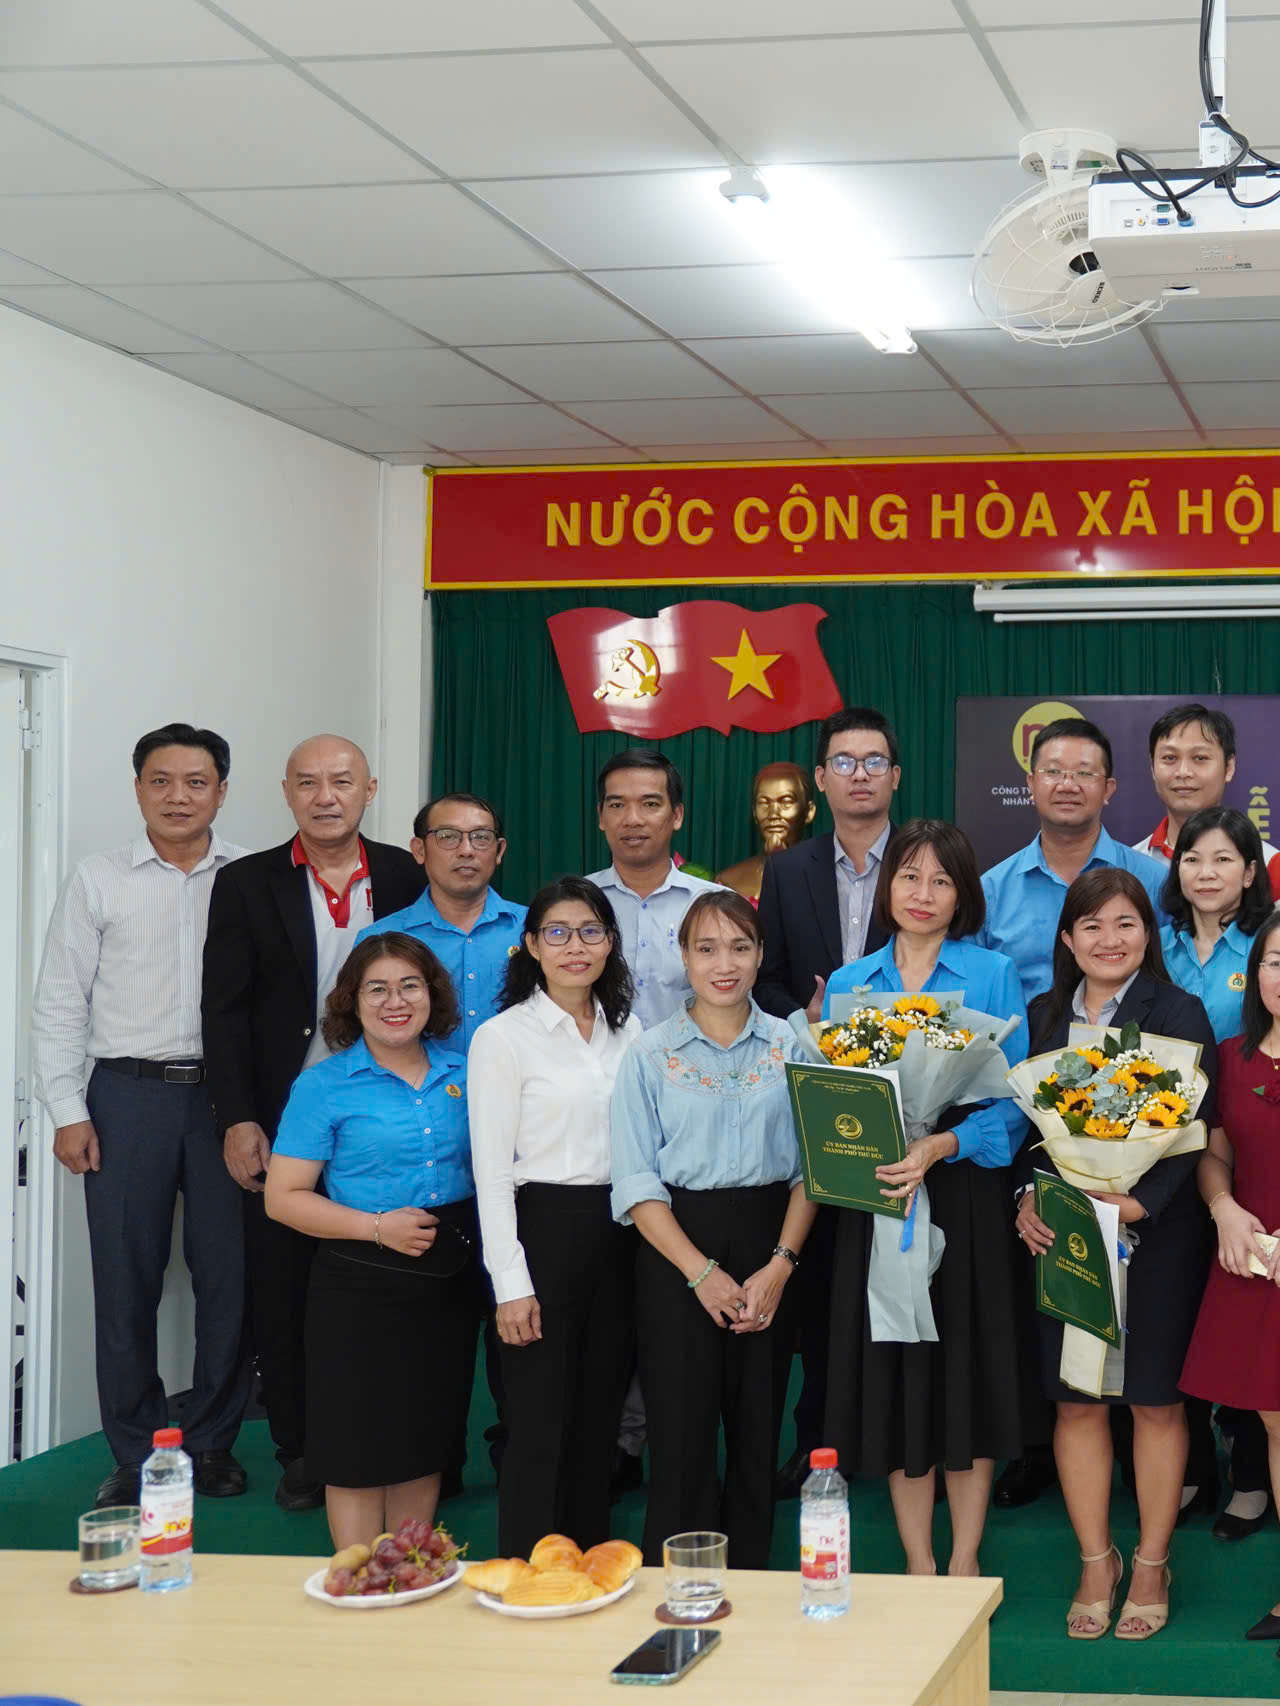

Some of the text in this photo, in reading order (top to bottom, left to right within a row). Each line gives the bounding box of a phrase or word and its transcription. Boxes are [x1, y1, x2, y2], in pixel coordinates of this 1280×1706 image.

[1092, 281, 1105, 303] SENKO
[546, 486, 714, 547] NƯỚC
[733, 482, 907, 554] CỘNG
[931, 479, 1057, 540] HÒA
[1077, 478, 1157, 537] XÃ
[991, 784, 1020, 795] CÔNG
[1002, 795, 1030, 805] NHÂN
